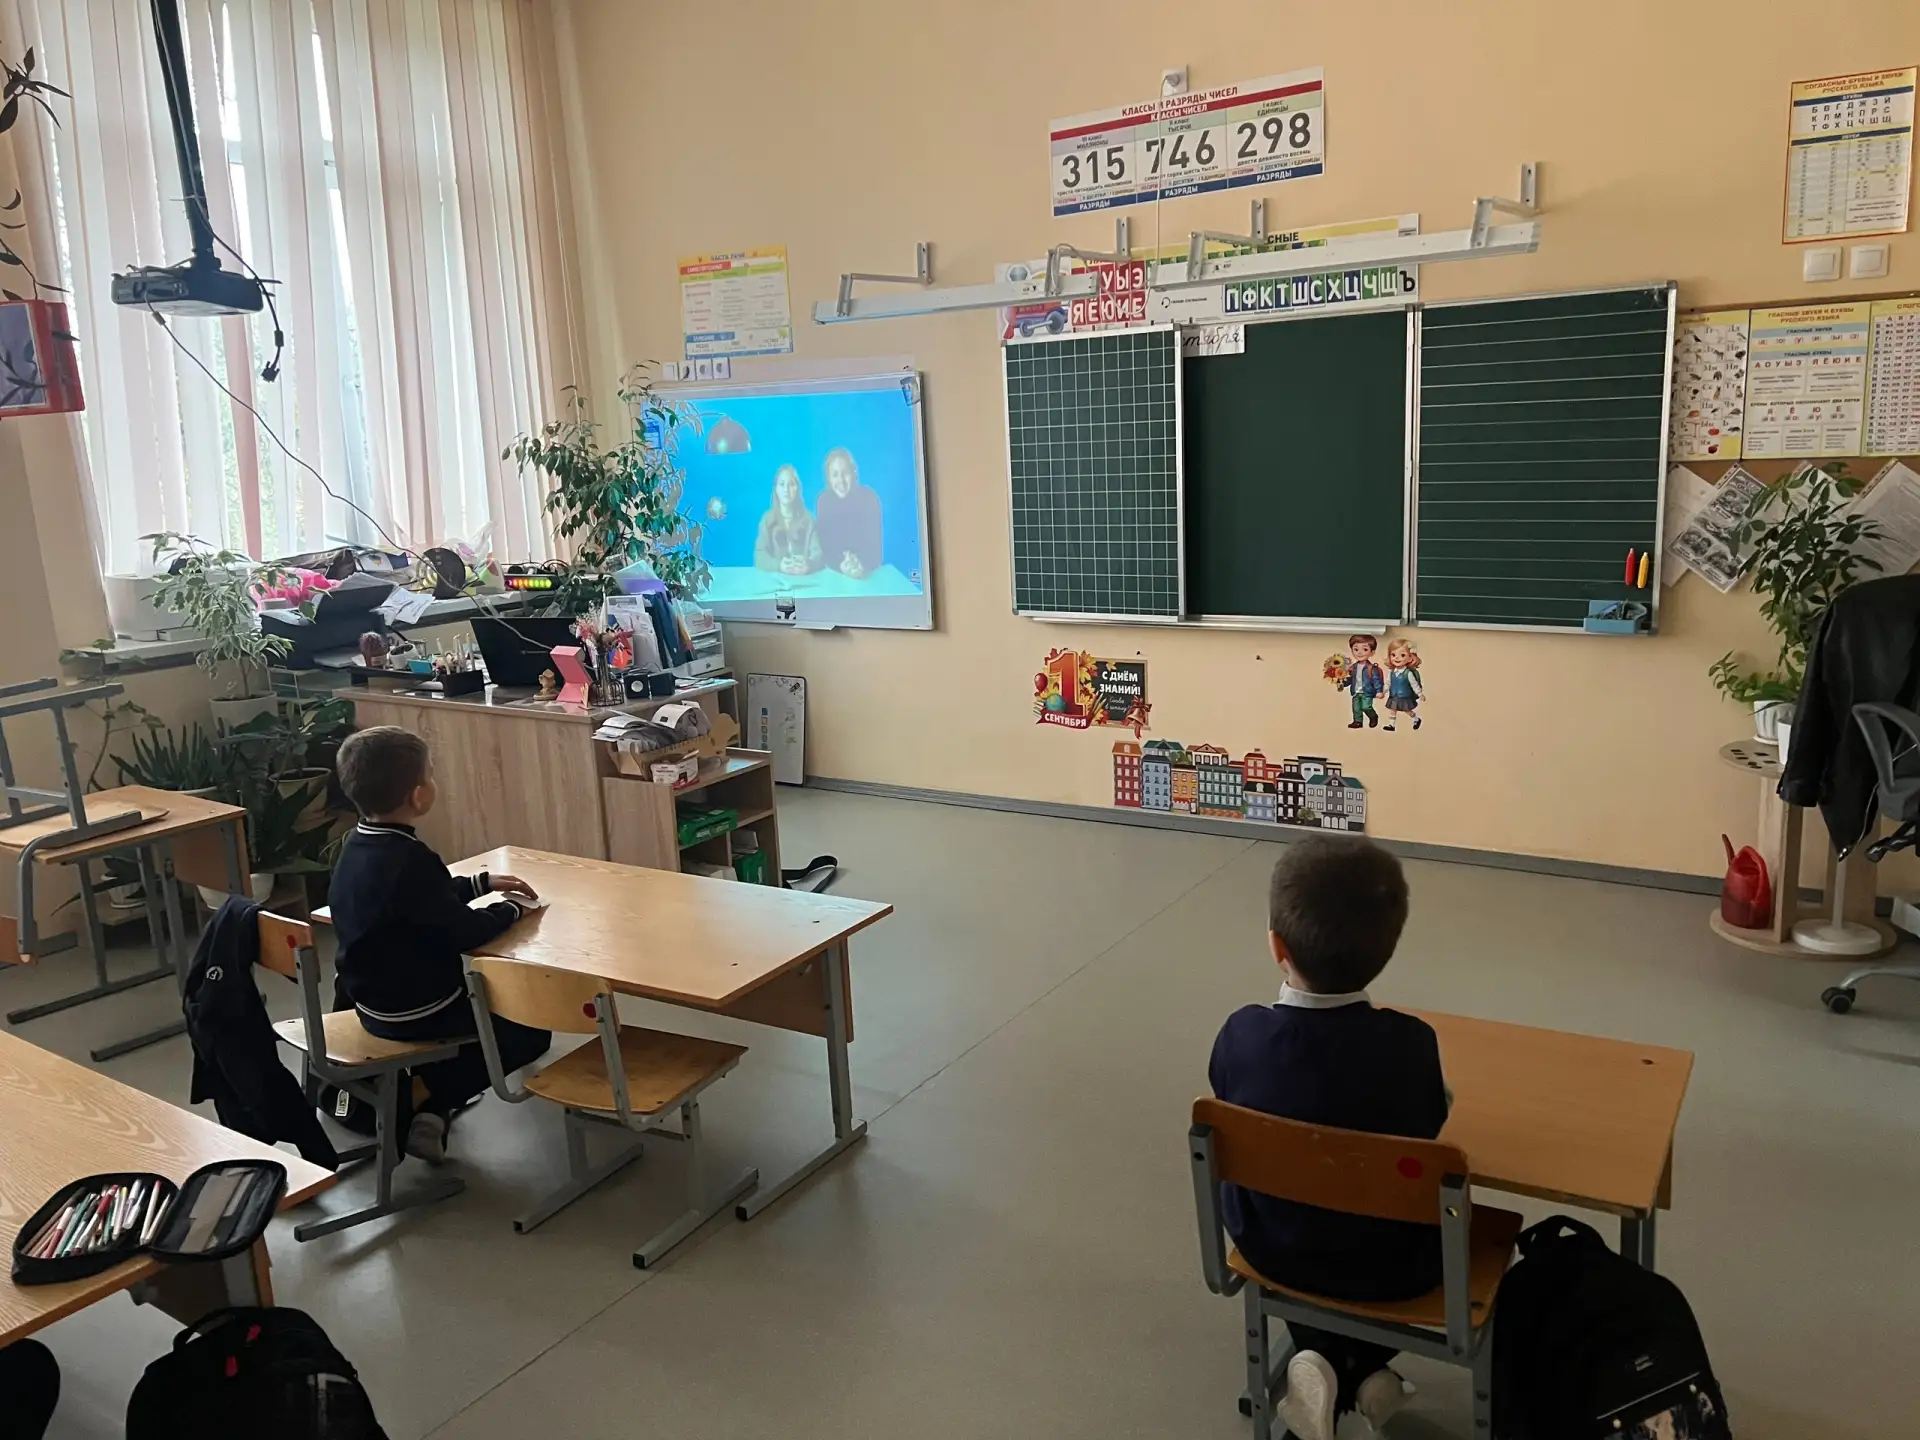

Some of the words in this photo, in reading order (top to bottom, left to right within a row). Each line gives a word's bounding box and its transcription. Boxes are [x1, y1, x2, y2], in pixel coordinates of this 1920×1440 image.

[1122, 103, 1156, 117] КЛАССЫ
[1166, 92, 1207, 108] РАЗРЯДЫ
[1209, 86, 1238, 100] ЧИСЕЛ
[1182, 104, 1208, 115] ЧИСЕЛ
[1257, 105, 1289, 116] ЕДИНИЦЫ
[1237, 112, 1311, 159] 298
[1146, 130, 1215, 174] 746
[1062, 145, 1125, 188] 315
[1256, 170, 1292, 182] РАЗРЯДЫ
[1165, 186, 1199, 196] РАЗРЯДЫ
[1080, 200, 1110, 210] РАЗРЯДЫ
[1102, 671, 1108, 680] С
[1109, 671, 1138, 682] ДНЁМ
[1099, 684, 1141, 695] ЗНАНИЙ!
[1044, 713, 1087, 727] СЕНТЯБРЯ
